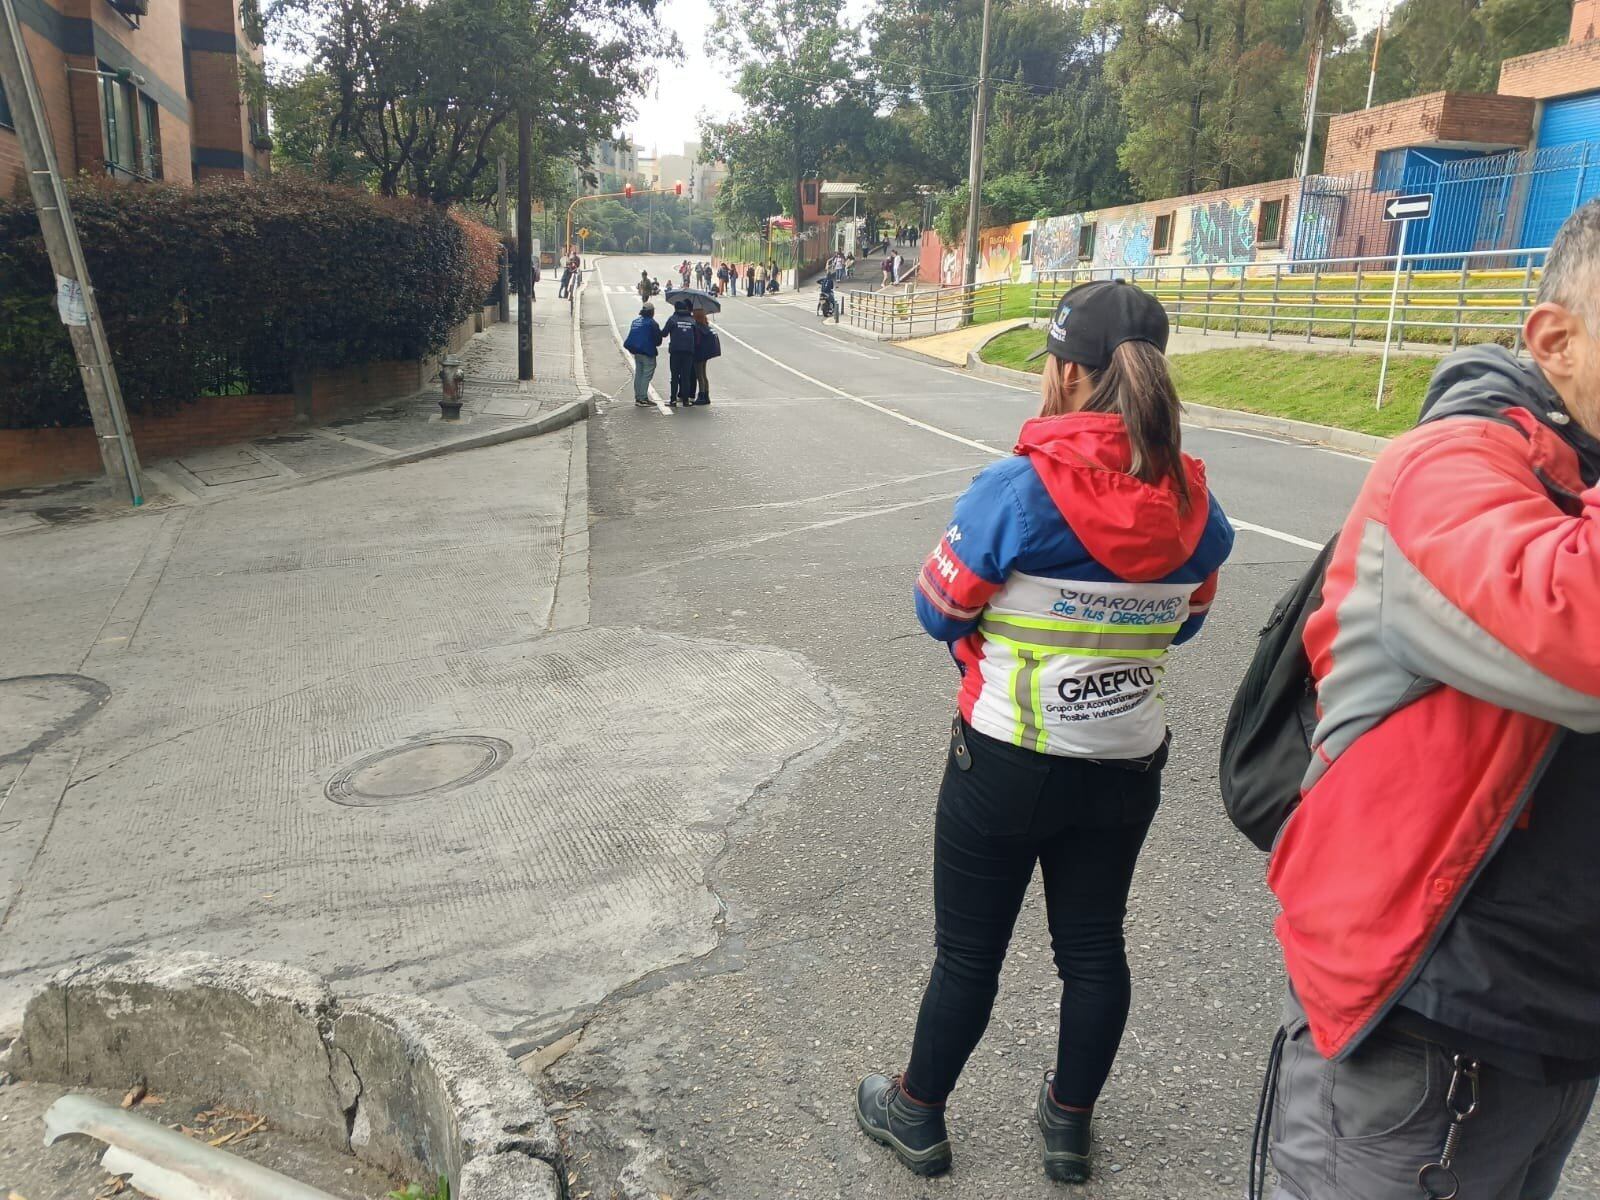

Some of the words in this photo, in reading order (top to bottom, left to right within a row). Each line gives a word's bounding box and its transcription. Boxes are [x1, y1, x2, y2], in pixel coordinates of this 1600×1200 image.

[1053, 600, 1077, 615] de
[1081, 606, 1105, 621] tus
[1046, 703, 1073, 713] Grupo
[1074, 703, 1085, 711] de
[1060, 712, 1090, 722] Posible
